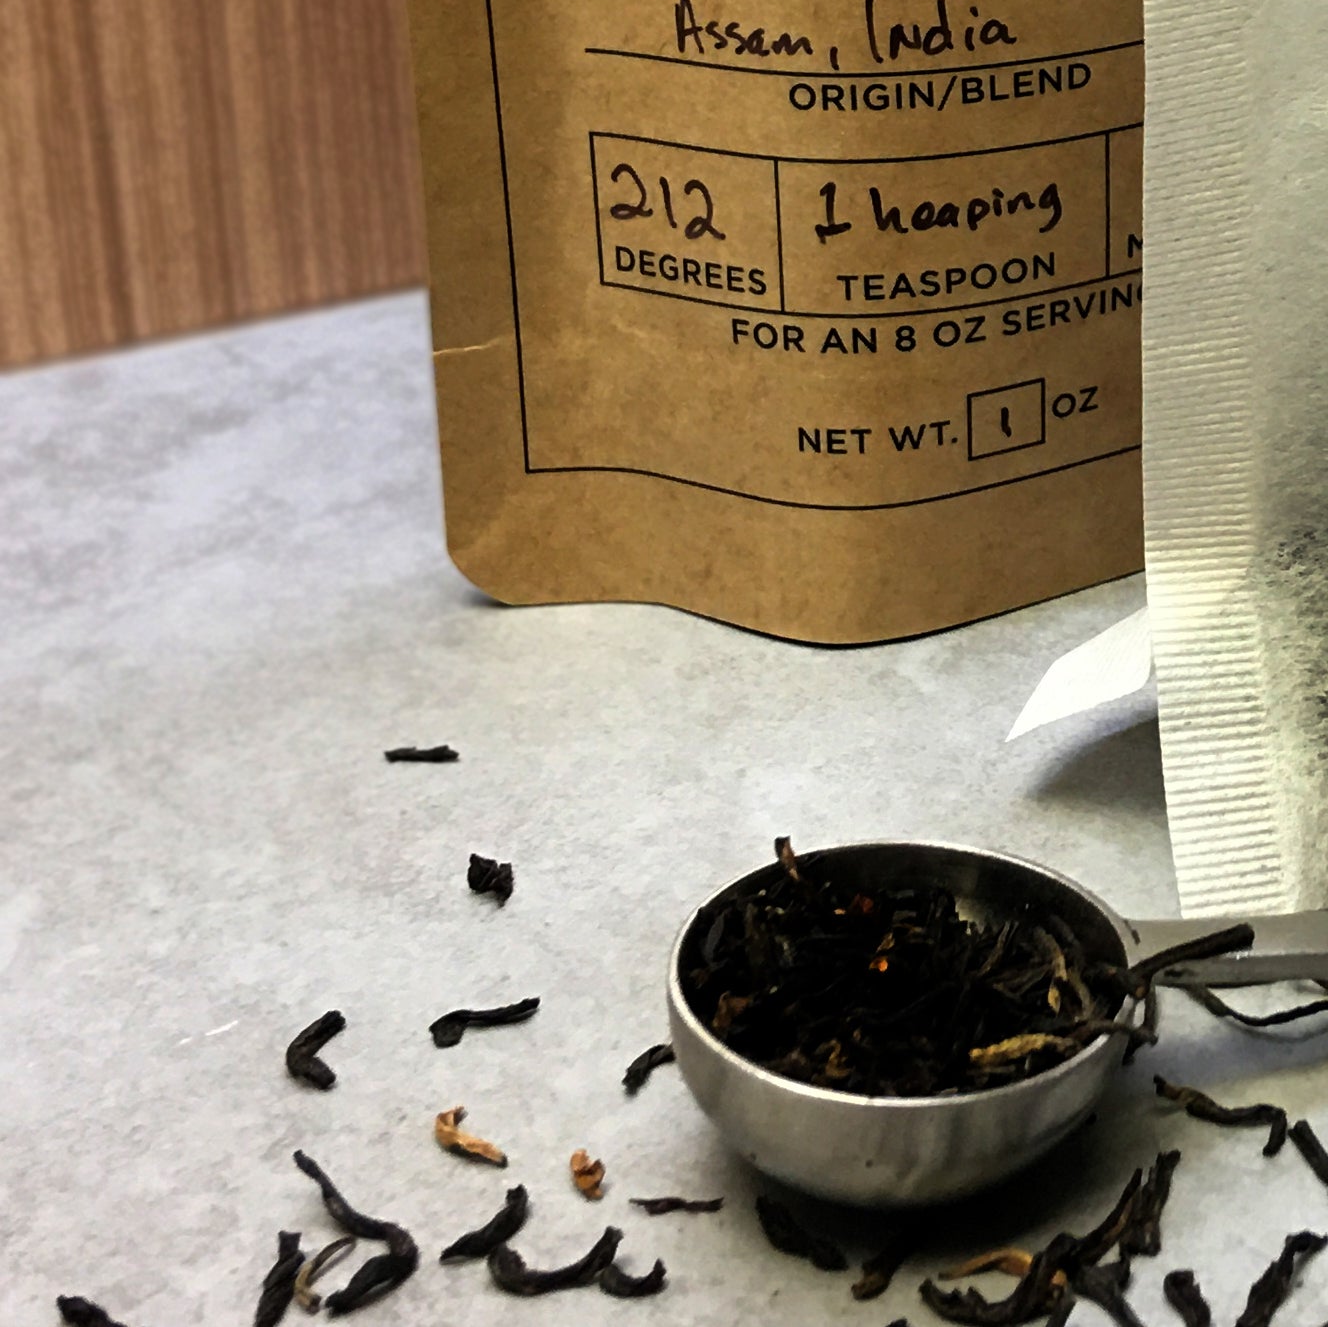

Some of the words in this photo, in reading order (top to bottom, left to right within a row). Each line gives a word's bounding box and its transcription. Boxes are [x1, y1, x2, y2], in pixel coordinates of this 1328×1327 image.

[789, 63, 1093, 112] ORIGIN/BLEND
[609, 163, 726, 240] 212
[814, 181, 853, 245] 1
[870, 182, 1064, 234] heaping
[614, 245, 768, 296] DEGREES
[837, 252, 1057, 302] TEASPOON
[731, 318, 806, 353] FOR
[821, 329, 879, 355] AN
[896, 327, 917, 353] 8
[933, 317, 987, 348] OZ
[1002, 282, 1142, 336] SERVIN
[1051, 386, 1099, 419] OZ
[798, 427, 872, 455] NET
[889, 420, 959, 452] WT.
